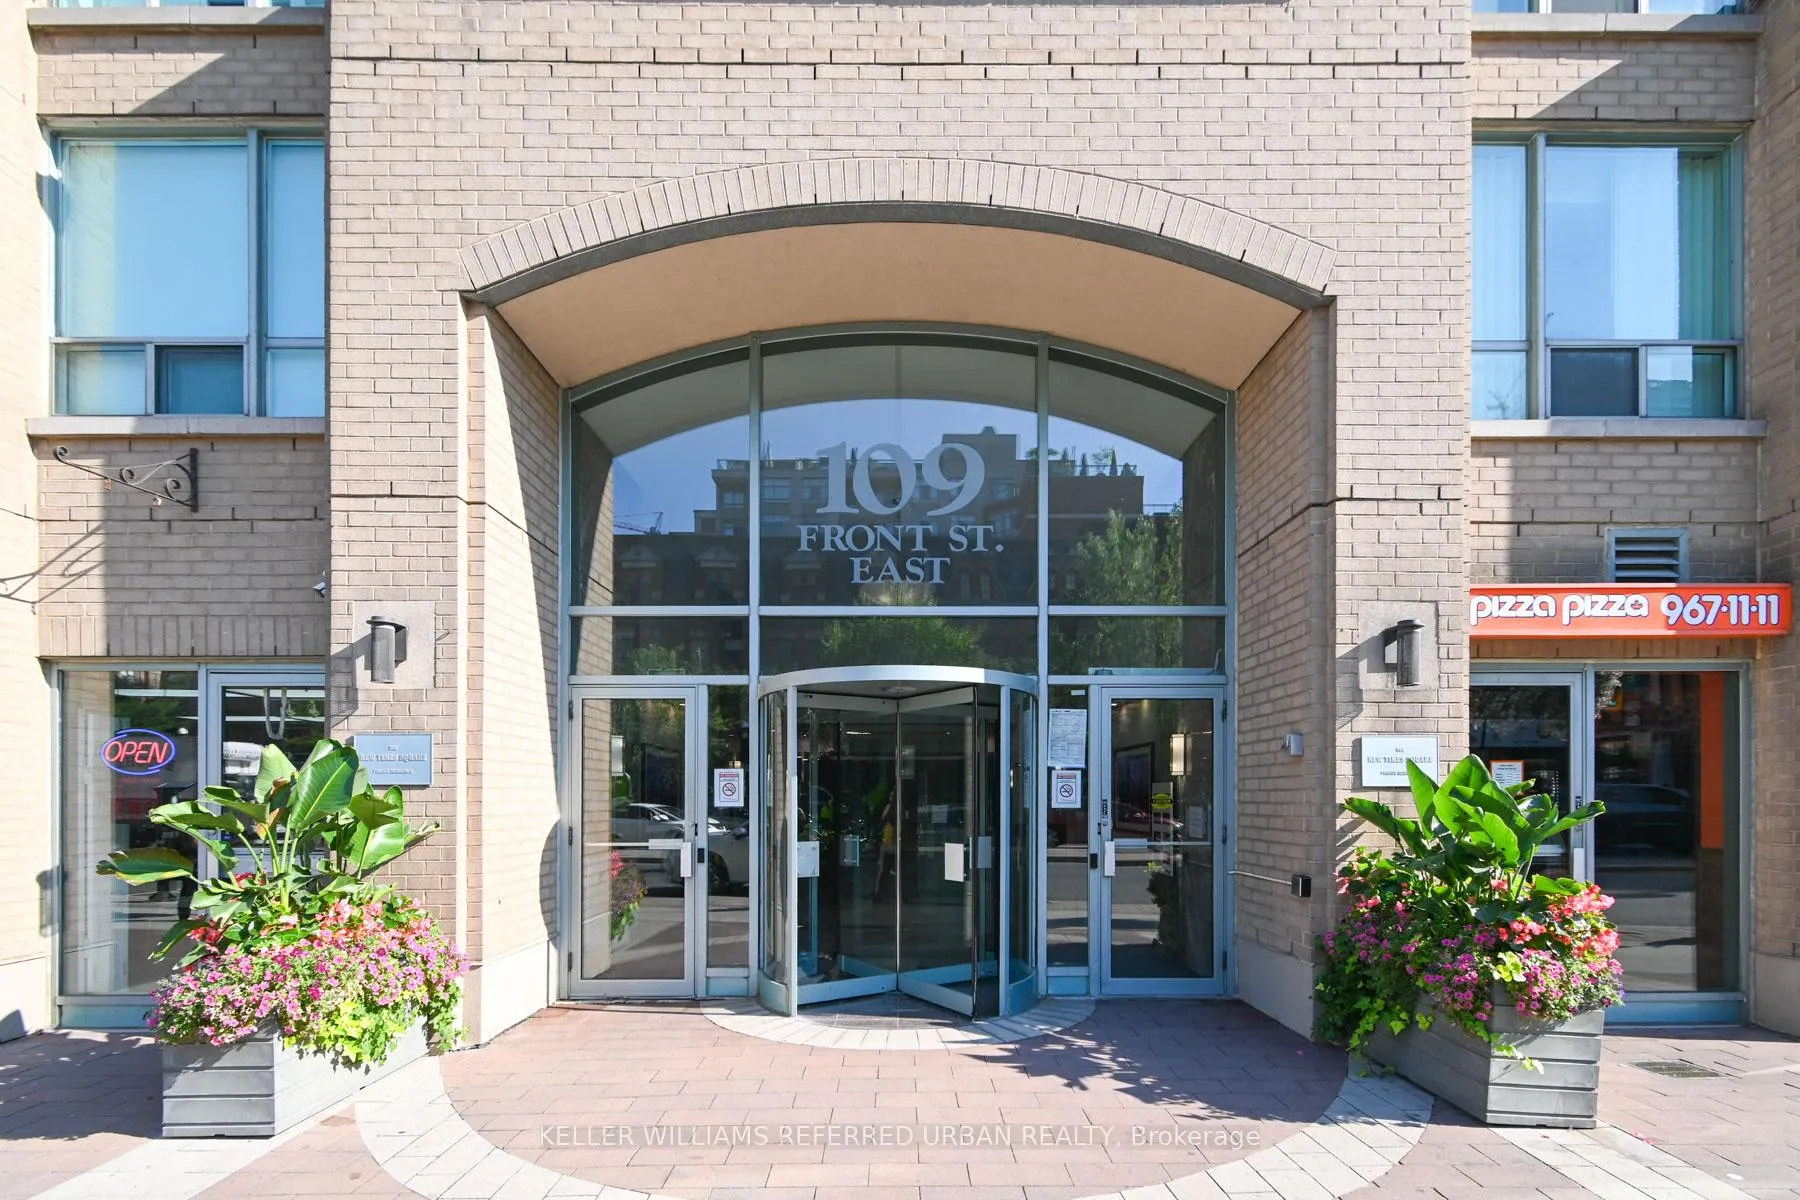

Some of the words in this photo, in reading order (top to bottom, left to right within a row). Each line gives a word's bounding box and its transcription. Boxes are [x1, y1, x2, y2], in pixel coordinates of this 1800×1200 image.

[816, 441, 985, 516] 109
[797, 525, 932, 552] FRONT
[949, 525, 1005, 553] ST.
[849, 557, 951, 584] EAST
[1469, 594, 1556, 626] pizza
[1561, 593, 1649, 626] pizza
[105, 740, 169, 764] OPEN
